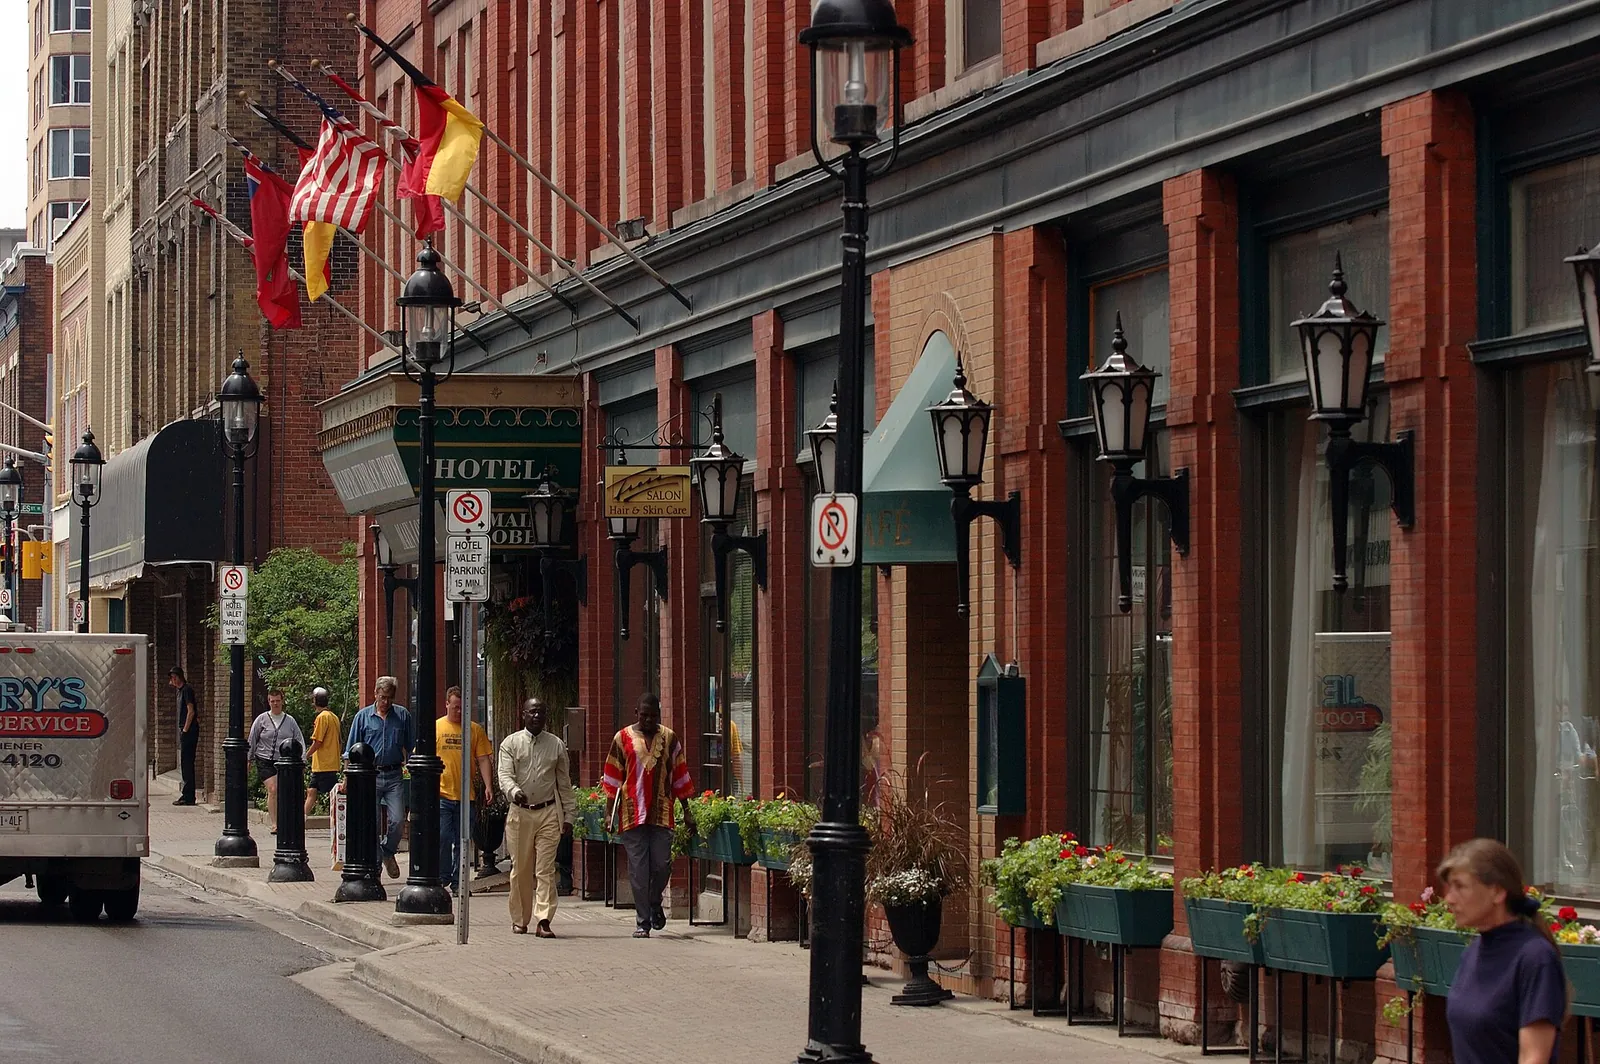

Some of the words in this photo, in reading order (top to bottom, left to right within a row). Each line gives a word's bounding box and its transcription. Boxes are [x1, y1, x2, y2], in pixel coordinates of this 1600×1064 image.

[434, 458, 541, 480] HOTEL
[646, 490, 681, 501] SALON
[609, 505, 629, 515] Hair
[632, 507, 640, 515] &
[643, 505, 663, 515] Skin
[666, 505, 687, 515] Care
[490, 512, 532, 528] MAI
[455, 541, 482, 550] HOTEL
[456, 554, 481, 562] VALET
[449, 566, 486, 575] PARKING
[455, 579, 463, 588] 15
[465, 579, 480, 588] MIN
[0, 716, 91, 731] ERVICE
